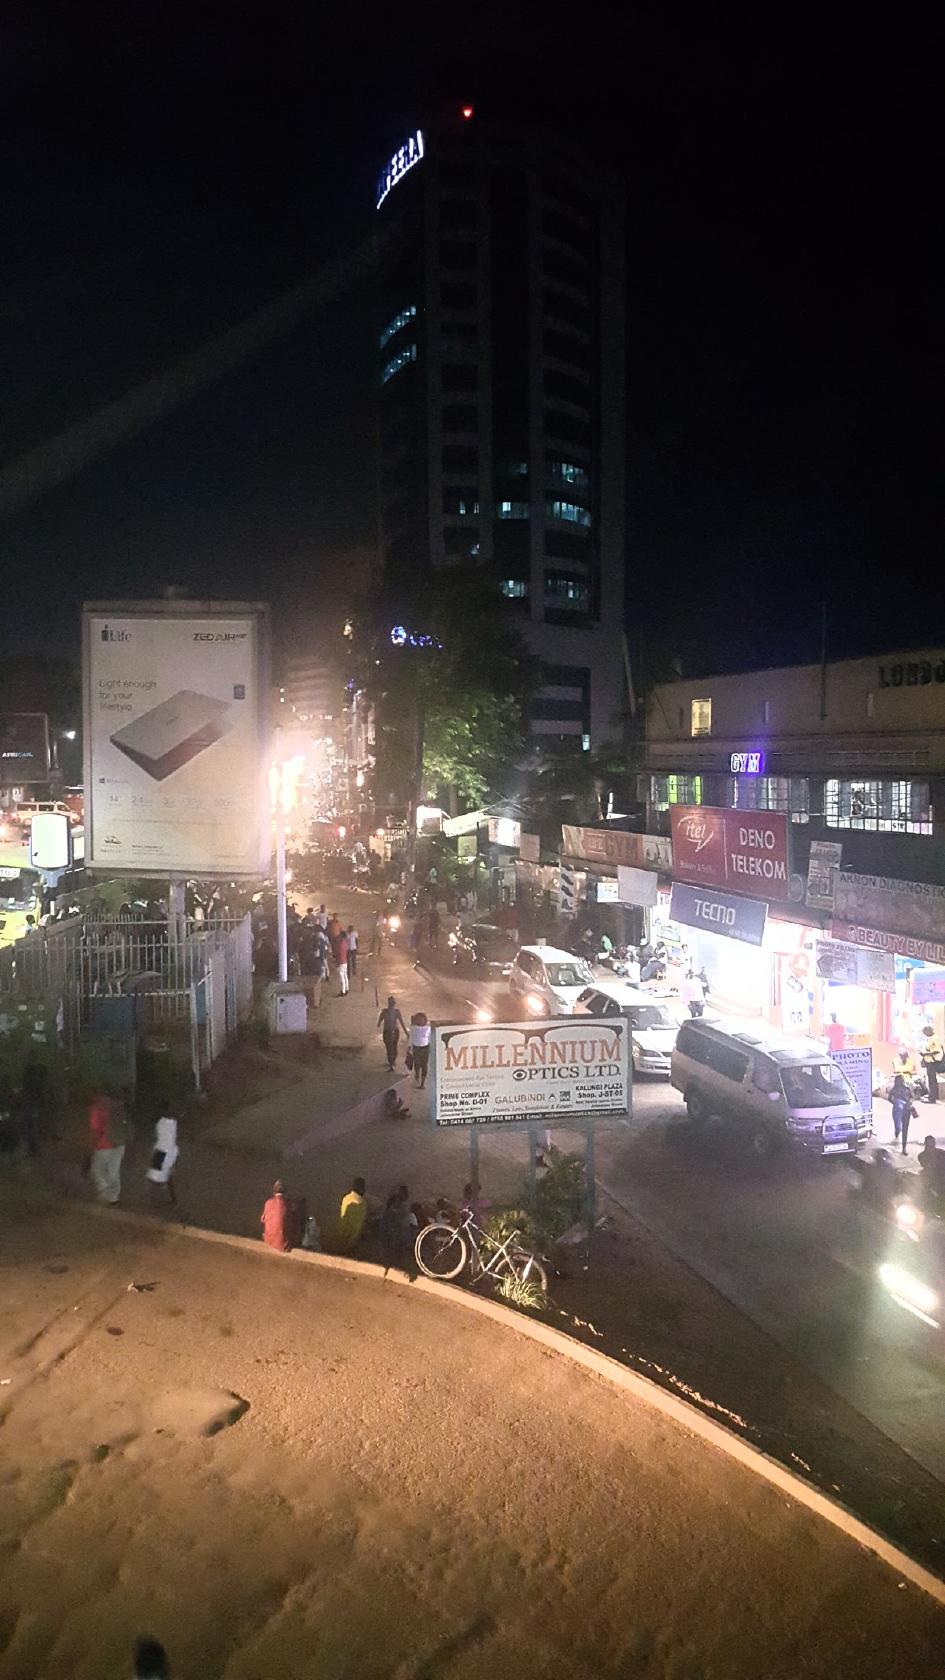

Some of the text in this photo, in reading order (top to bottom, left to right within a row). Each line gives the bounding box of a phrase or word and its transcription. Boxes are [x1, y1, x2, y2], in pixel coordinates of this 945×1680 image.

[731, 753, 761, 773] GYM
[686, 820, 706, 839] itel
[739, 827, 776, 850] DENO
[731, 853, 787, 880] TELEKOM
[694, 898, 736, 925] TECNO
[857, 926, 905, 953] BEAUTY
[907, 937, 924, 958] BY
[445, 1039, 622, 1071] MILLENNIUM
[832, 1051, 870, 1060] PHOTO
[460, 1091, 490, 1099] COMPLEX
